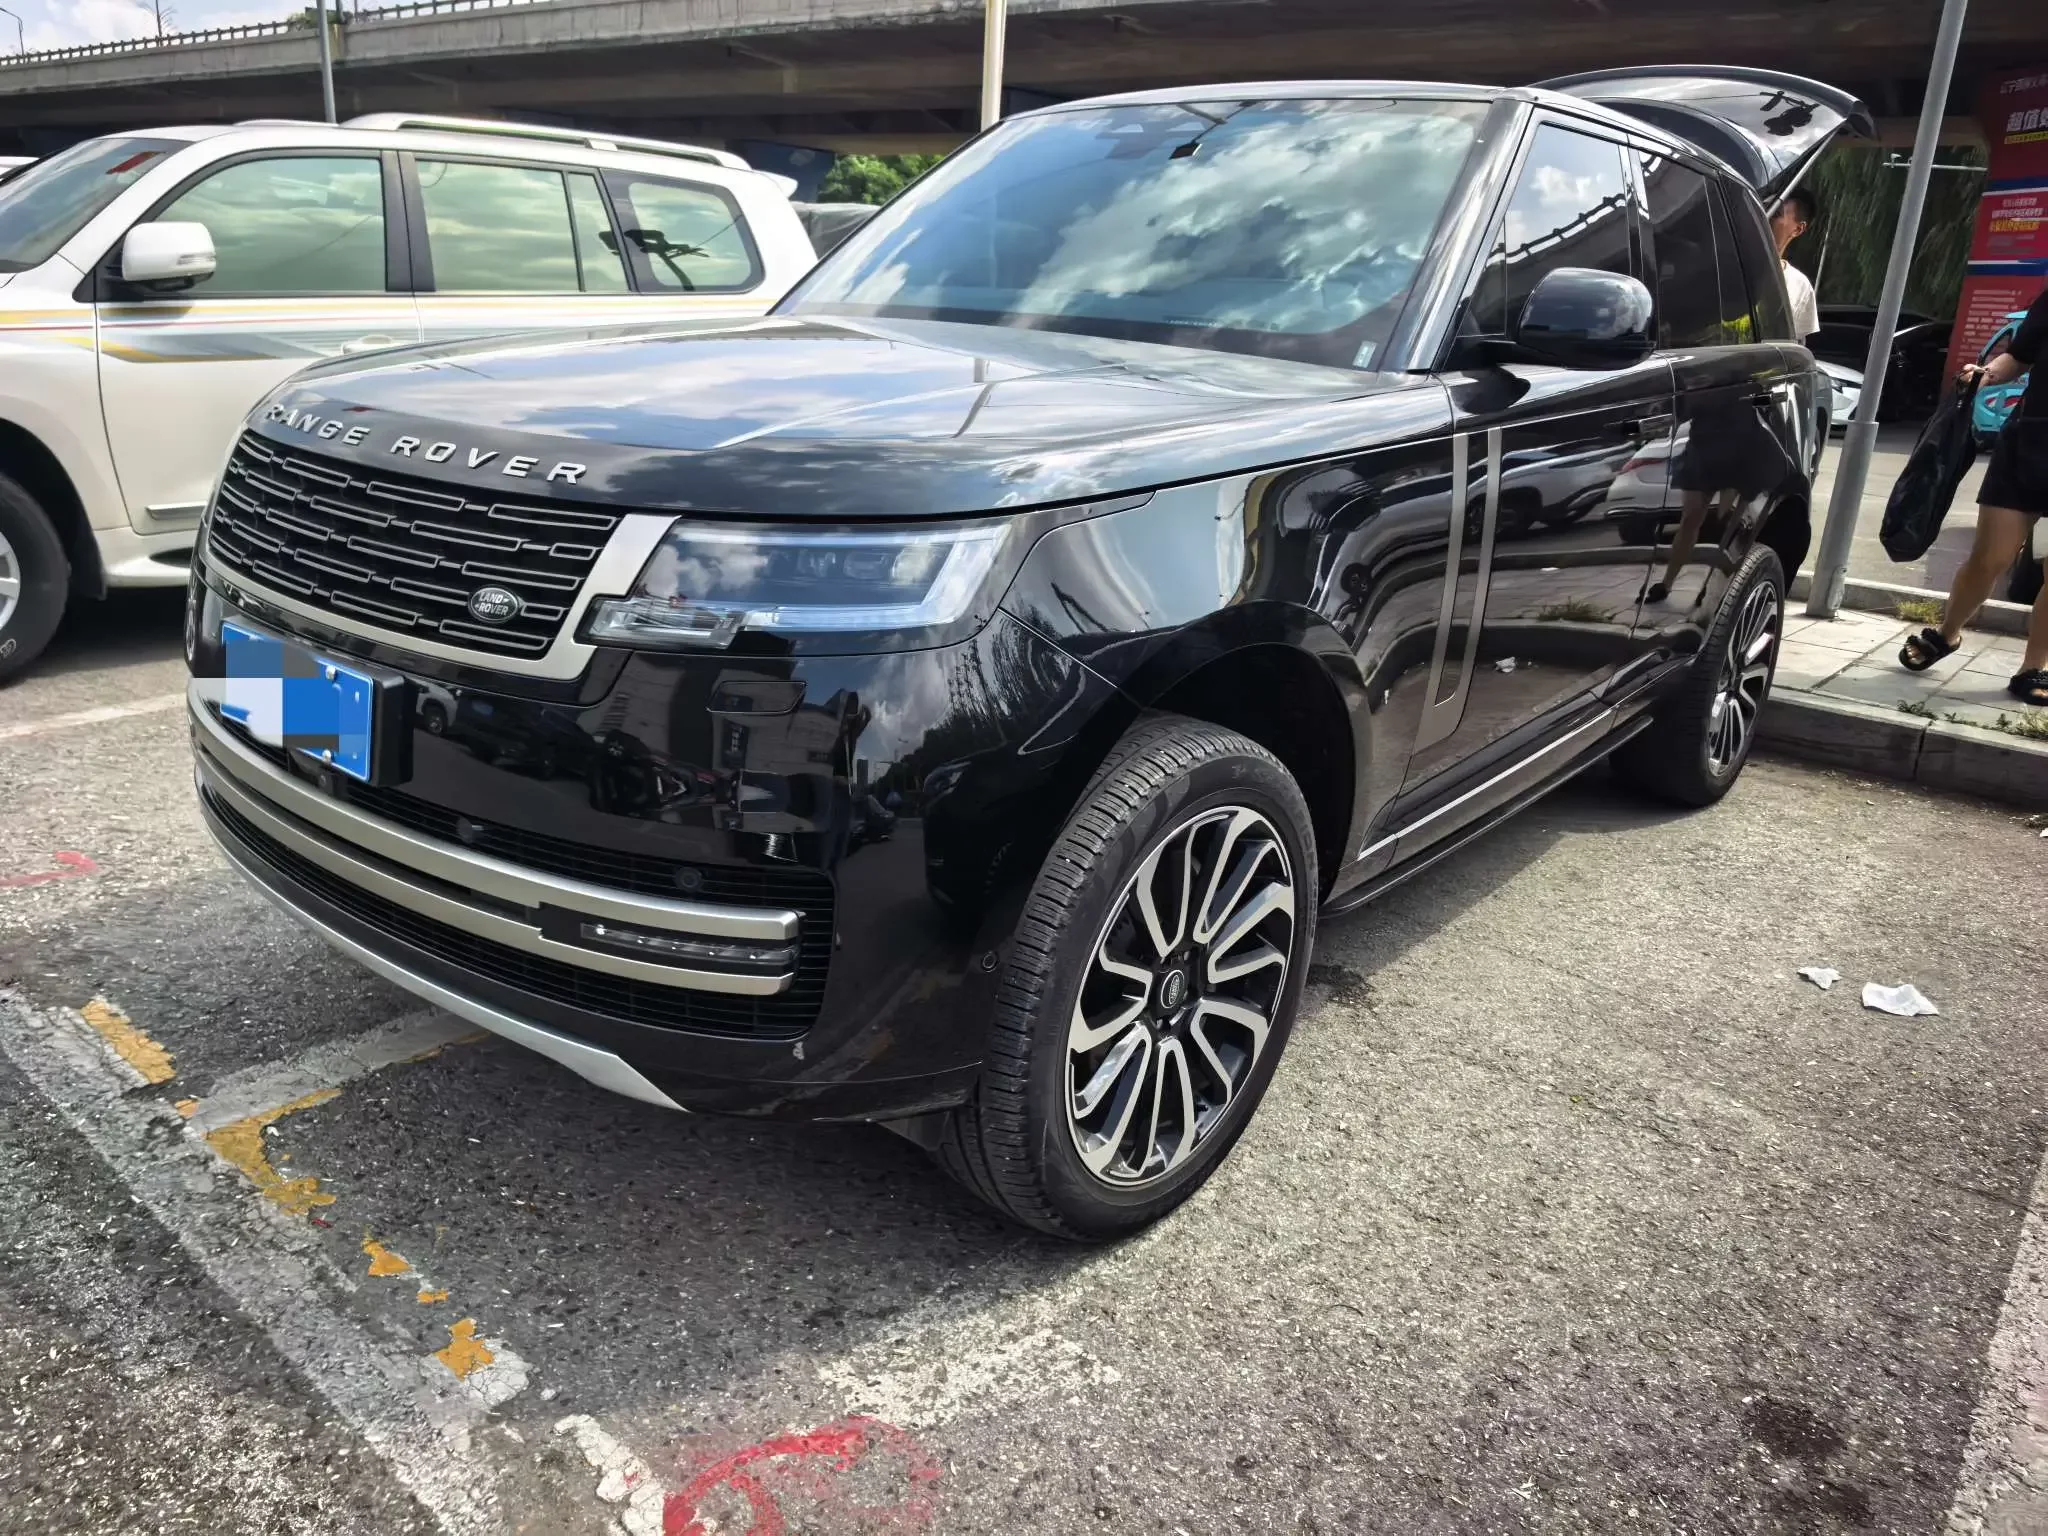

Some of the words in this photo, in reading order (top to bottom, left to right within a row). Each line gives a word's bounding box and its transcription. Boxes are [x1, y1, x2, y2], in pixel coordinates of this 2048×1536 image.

[264, 403, 370, 446] RANGE
[390, 435, 587, 485] ROVER
[479, 591, 504, 604] LAND
[478, 602, 509, 616] ROVER
